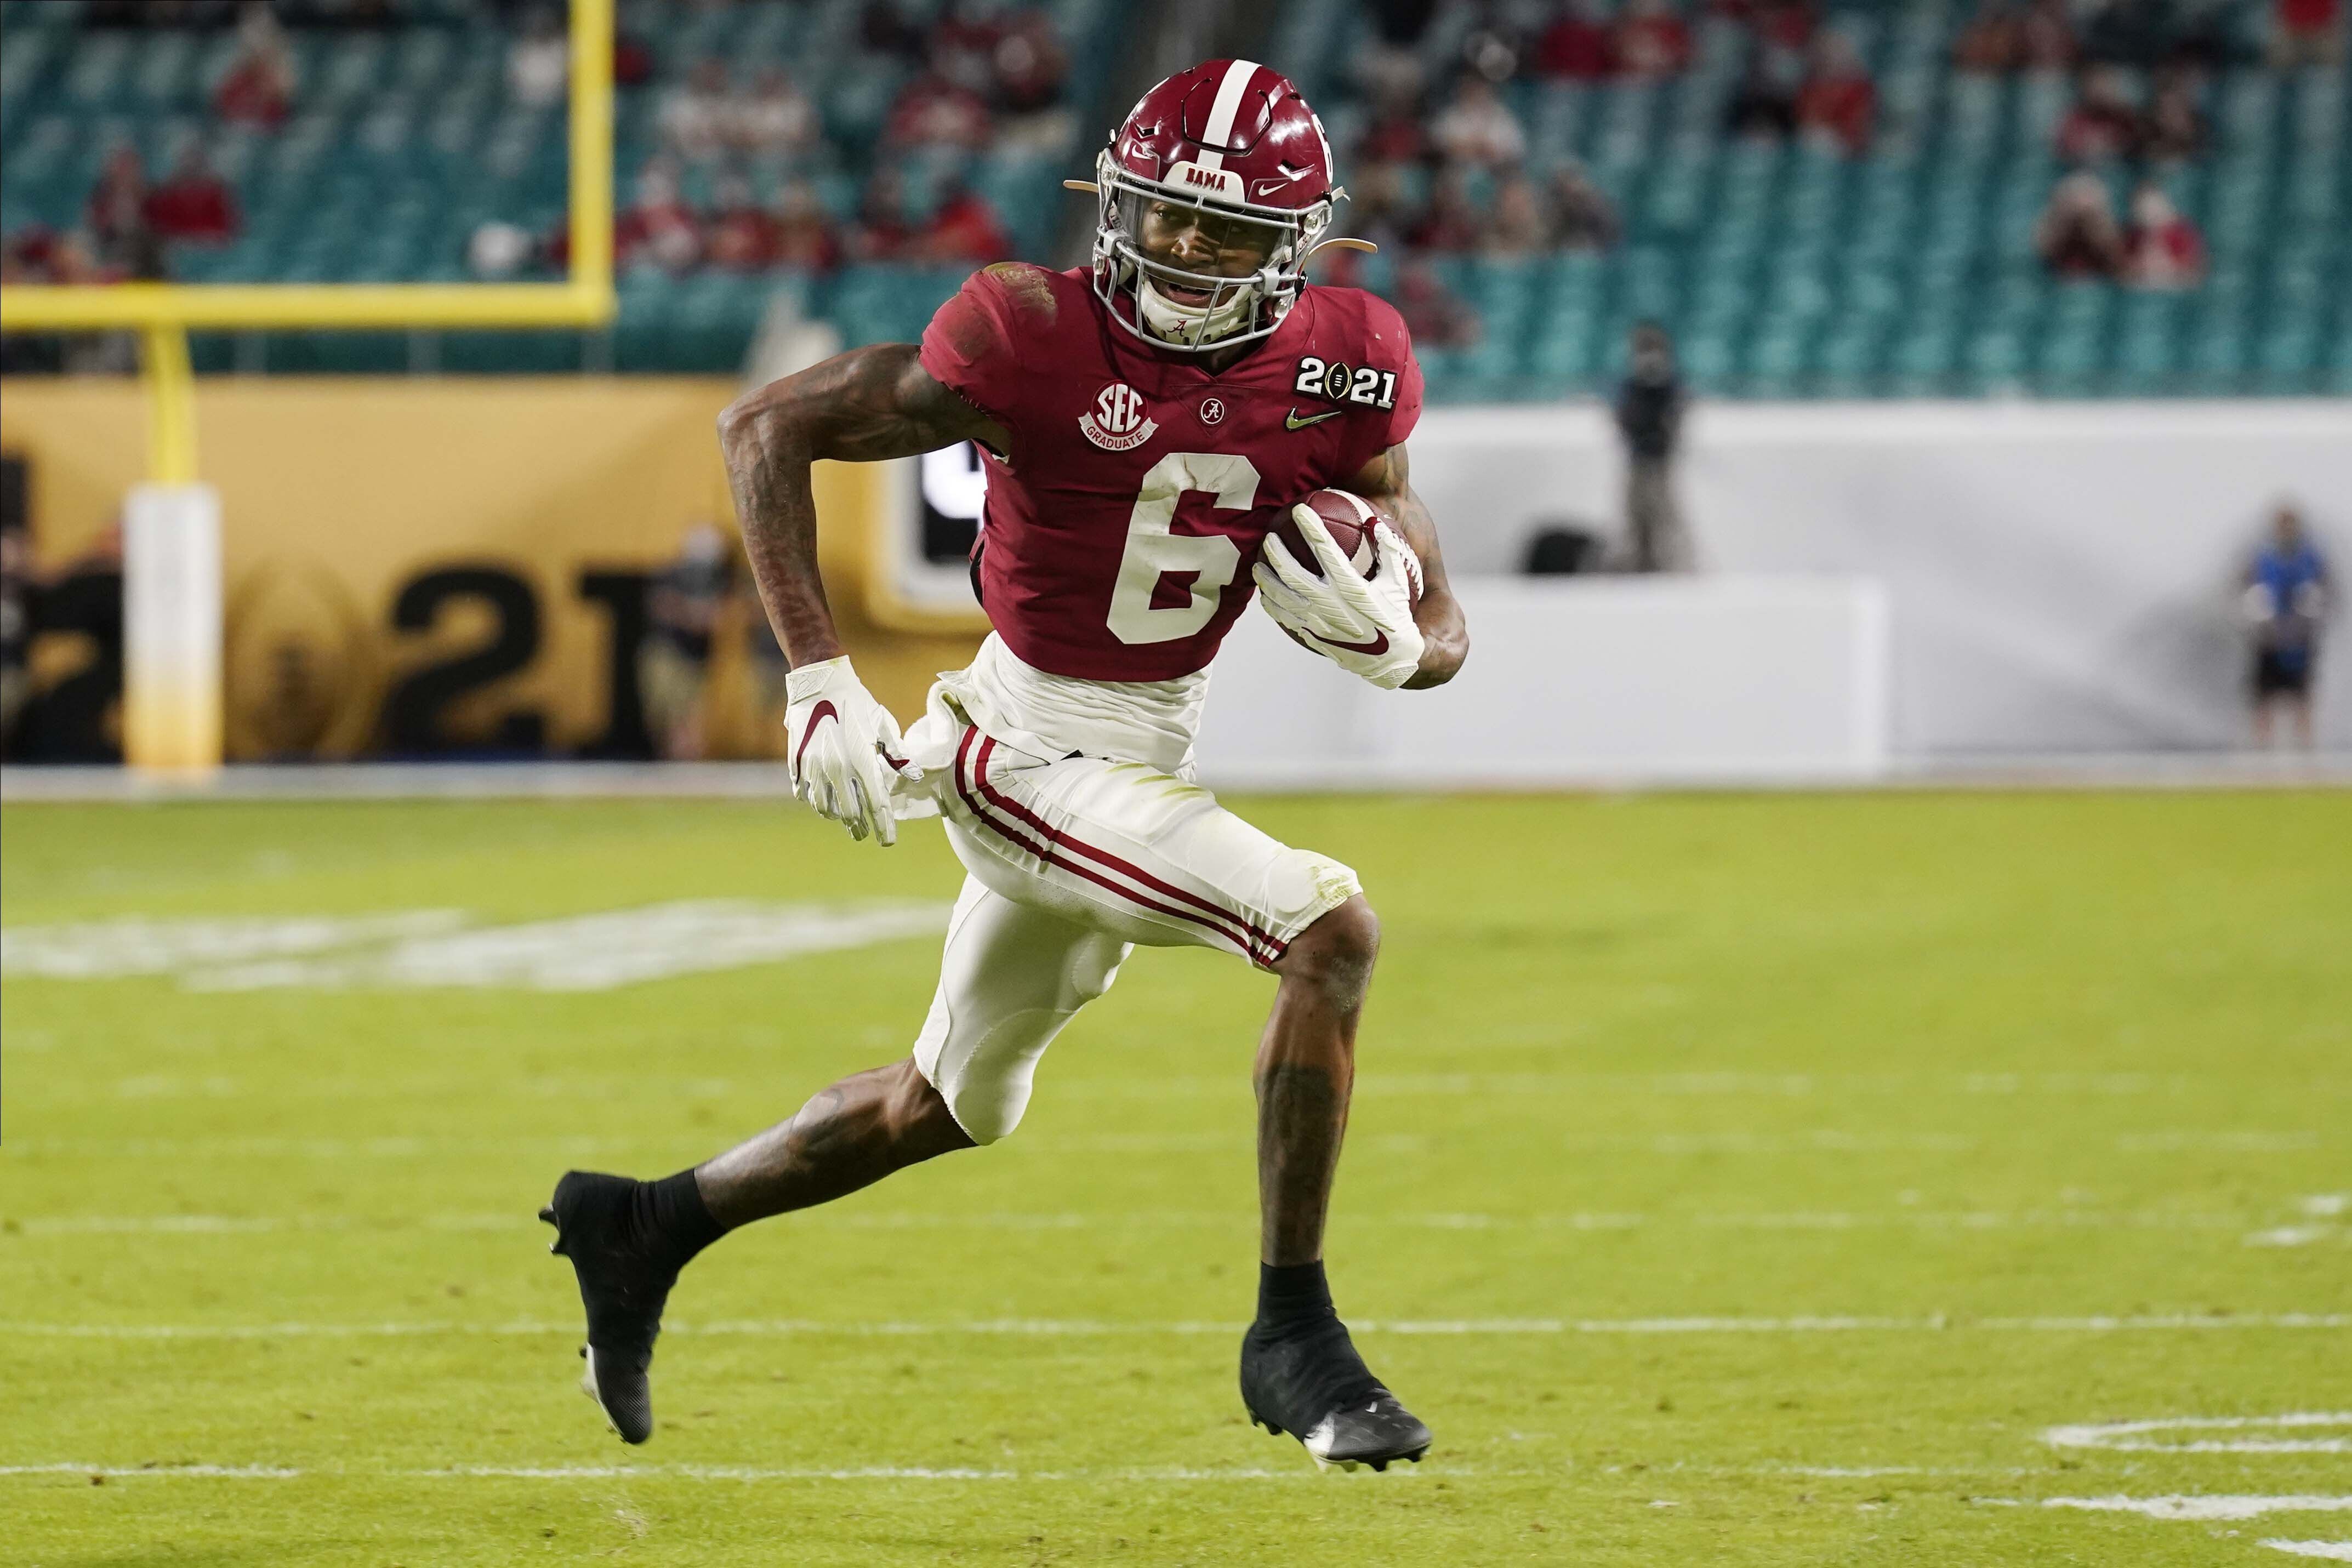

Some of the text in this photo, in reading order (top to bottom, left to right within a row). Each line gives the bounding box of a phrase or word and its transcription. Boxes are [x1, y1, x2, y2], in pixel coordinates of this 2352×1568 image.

[1185, 168, 1226, 191] BAMA
[1168, 320, 1187, 337] A
[1296, 357, 1396, 409] 2021
[1097, 384, 1143, 432] SEC
[1204, 402, 1219, 418] A
[1086, 426, 1145, 449] GRADUATE
[1106, 453, 1261, 645] 6
